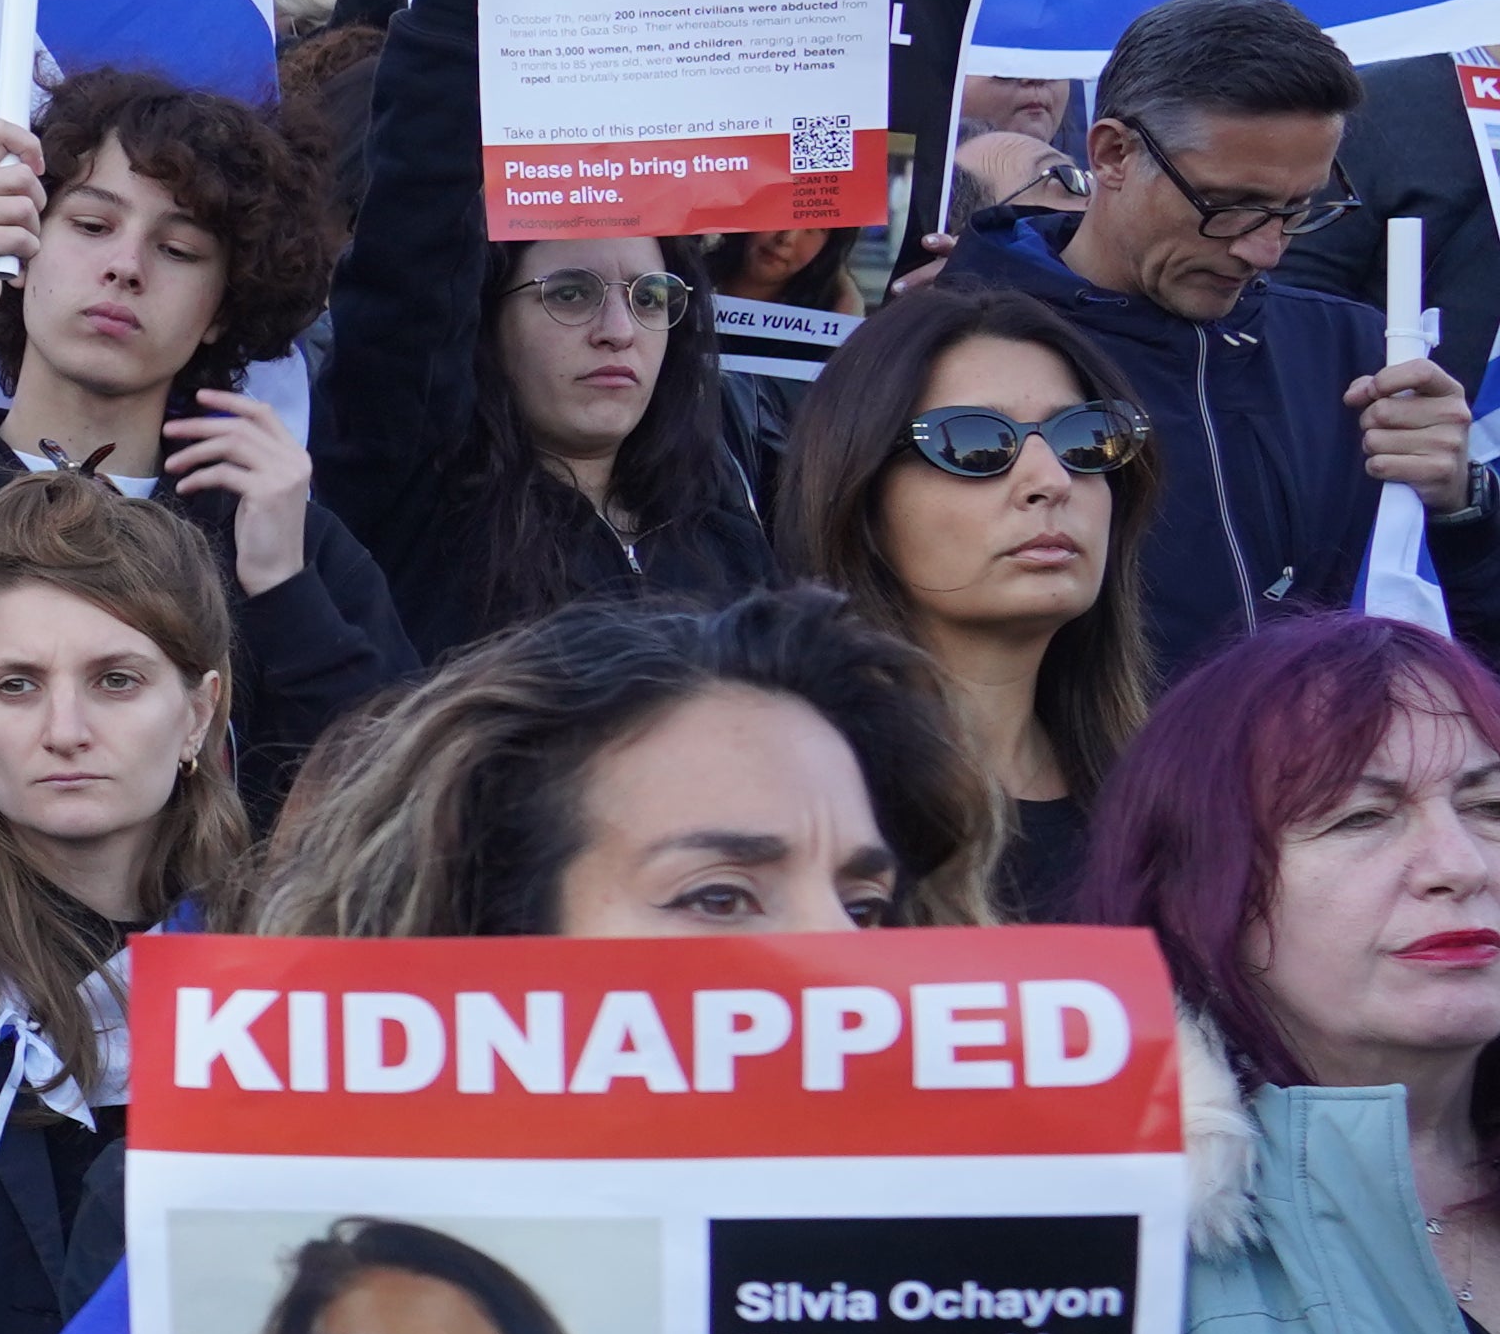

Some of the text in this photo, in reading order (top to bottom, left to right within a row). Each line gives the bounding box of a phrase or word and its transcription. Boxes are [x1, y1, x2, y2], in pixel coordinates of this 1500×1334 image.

[503, 116, 773, 141] Take a photo of this poster and share it
[505, 154, 748, 181] Please help bring them
[506, 185, 623, 206] home alive.
[762, 314, 816, 336] YUVAL,
[821, 321, 839, 336] 11
[176, 980, 1128, 1093] KIDNAPPED
[736, 1281, 1121, 1327] Silvia Ochayon
